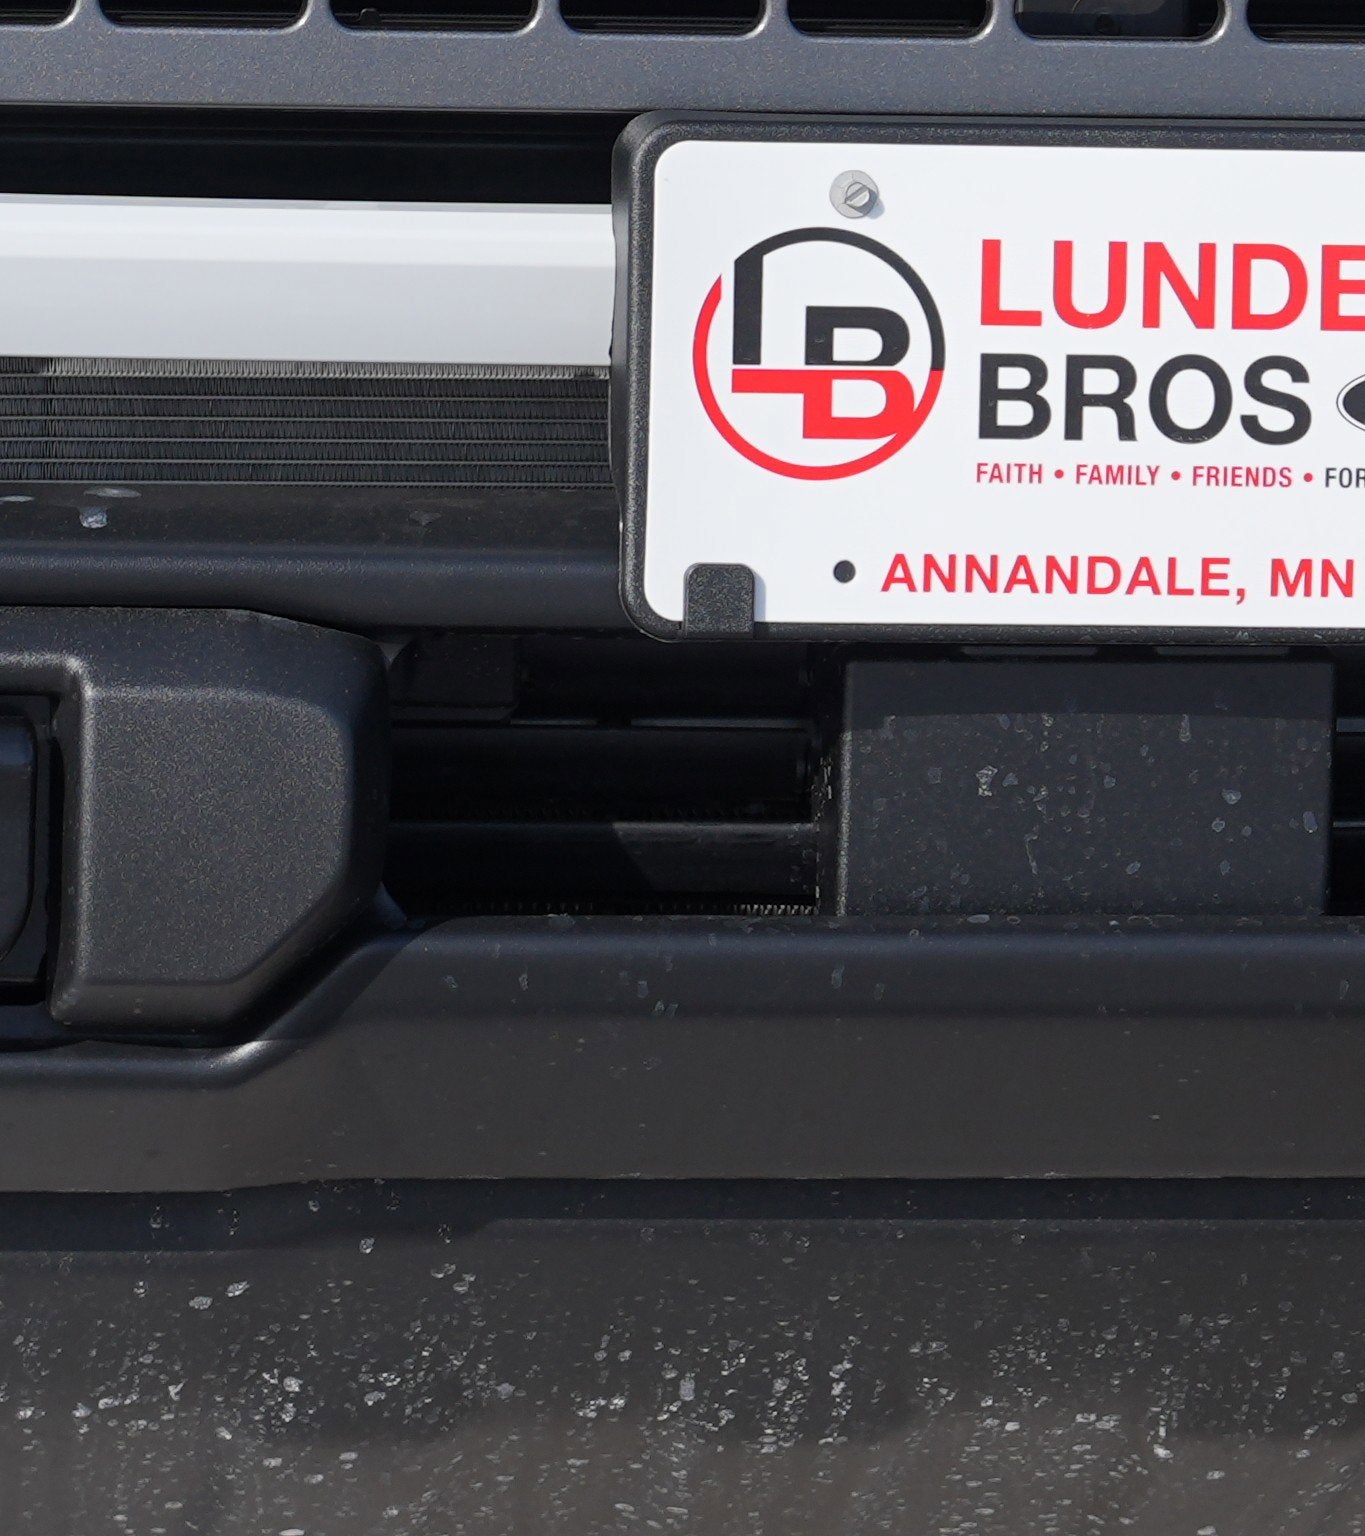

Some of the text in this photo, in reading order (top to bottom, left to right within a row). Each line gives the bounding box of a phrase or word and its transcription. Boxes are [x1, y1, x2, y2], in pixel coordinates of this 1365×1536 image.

[978, 352, 1312, 446] BROS
[976, 462, 1043, 484] FAITH
[1075, 464, 1160, 486] FAMILY
[1192, 465, 1292, 488] FRIENDS
[881, 553, 1354, 605] ANNANDALE, MN
